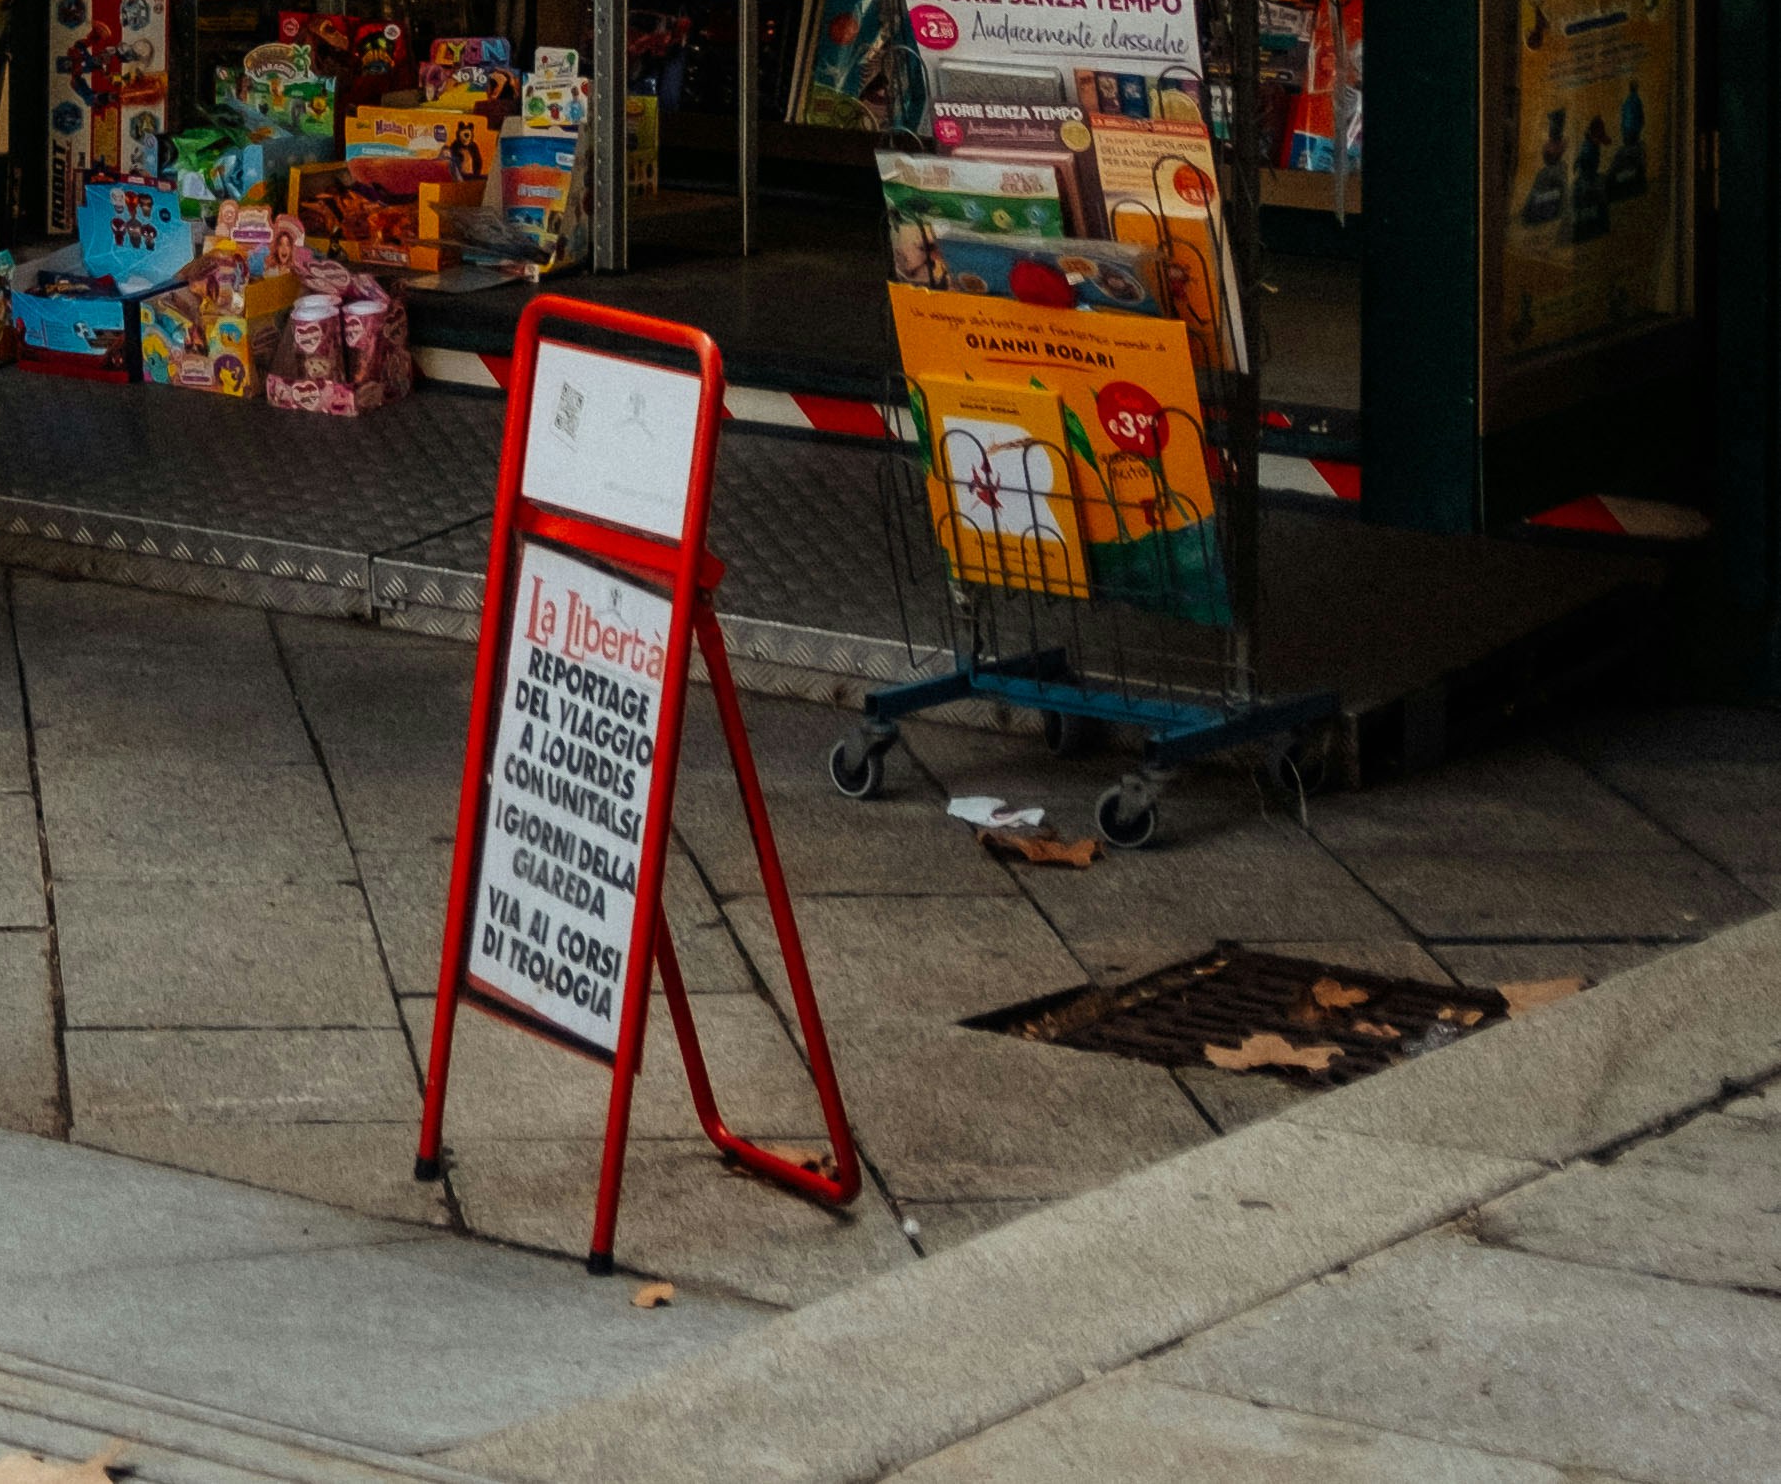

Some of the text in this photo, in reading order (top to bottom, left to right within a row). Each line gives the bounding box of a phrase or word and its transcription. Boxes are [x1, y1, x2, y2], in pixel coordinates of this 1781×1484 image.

[972, 10, 1189, 55] Audacemente classiche
[934, 102, 1084, 122] STORIE SENZA TEMPO
[965, 333, 1116, 370] GIANNI RODARI
[523, 575, 667, 682] La Libertà
[515, 677, 654, 767] DEL VIAGGIO
[528, 645, 651, 729] REPORTAGE
[519, 721, 636, 801] A LOURDES
[504, 803, 578, 865] GIORNI
[577, 838, 638, 898] DELLA
[512, 847, 607, 923] GIAREDA
[481, 922, 613, 1023] DI TEOLOGIA
[488, 883, 624, 984] VIA AI CORSI
